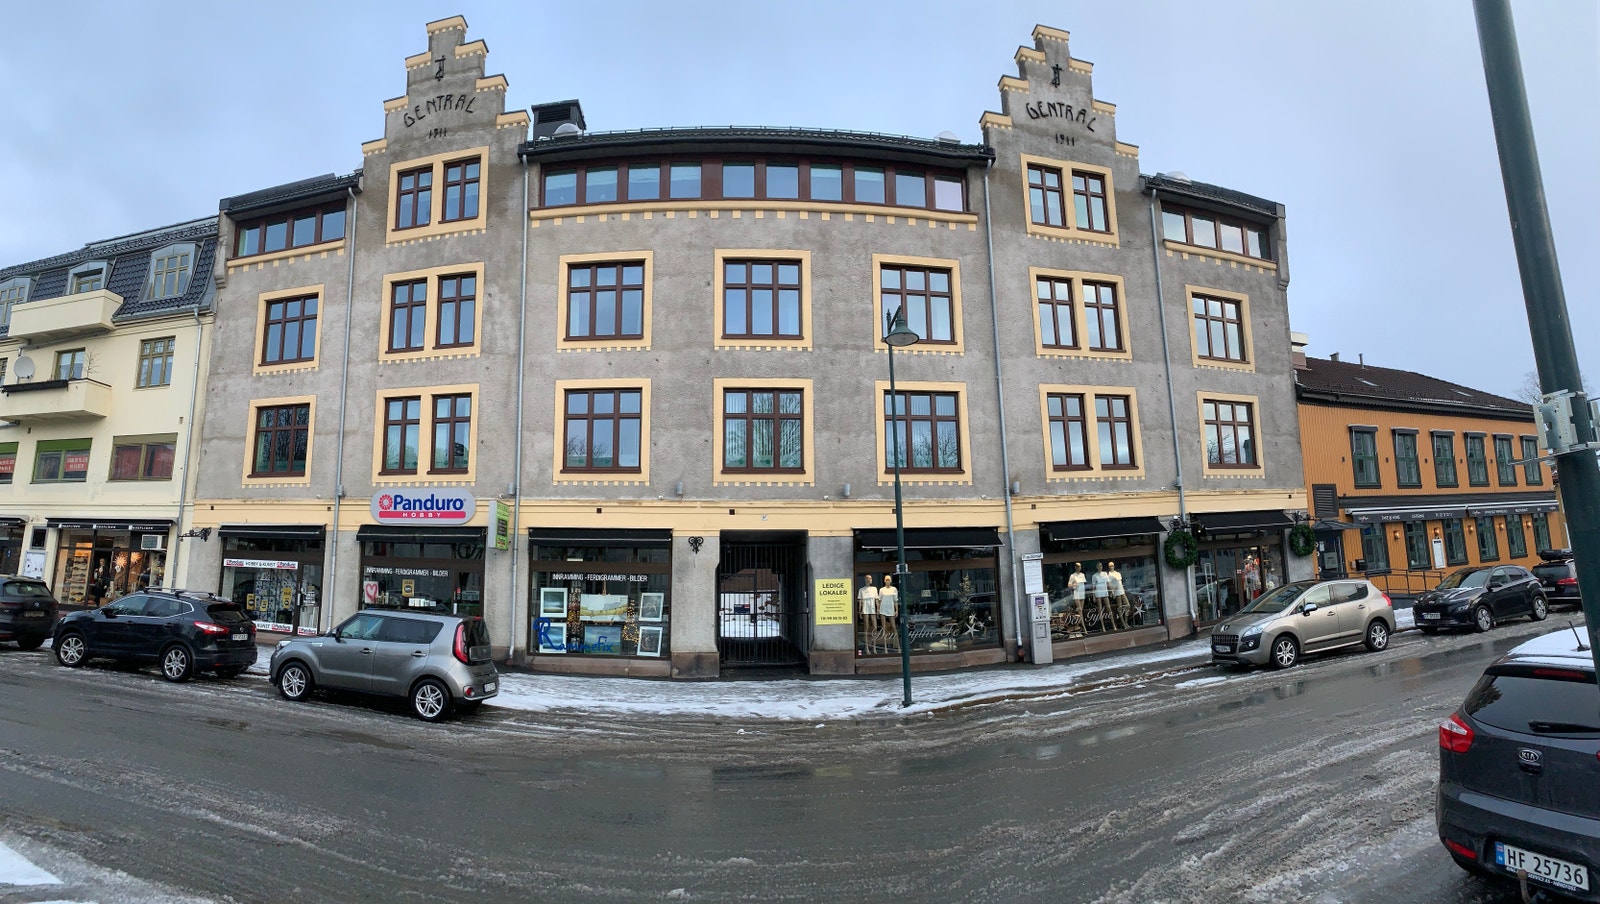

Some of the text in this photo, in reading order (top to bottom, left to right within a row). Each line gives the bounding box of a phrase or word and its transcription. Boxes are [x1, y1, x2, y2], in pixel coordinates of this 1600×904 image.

[393, 493, 465, 511] Panduro
[1520, 751, 1537, 761] KIA
[1507, 848, 1583, 885] HF 25736
